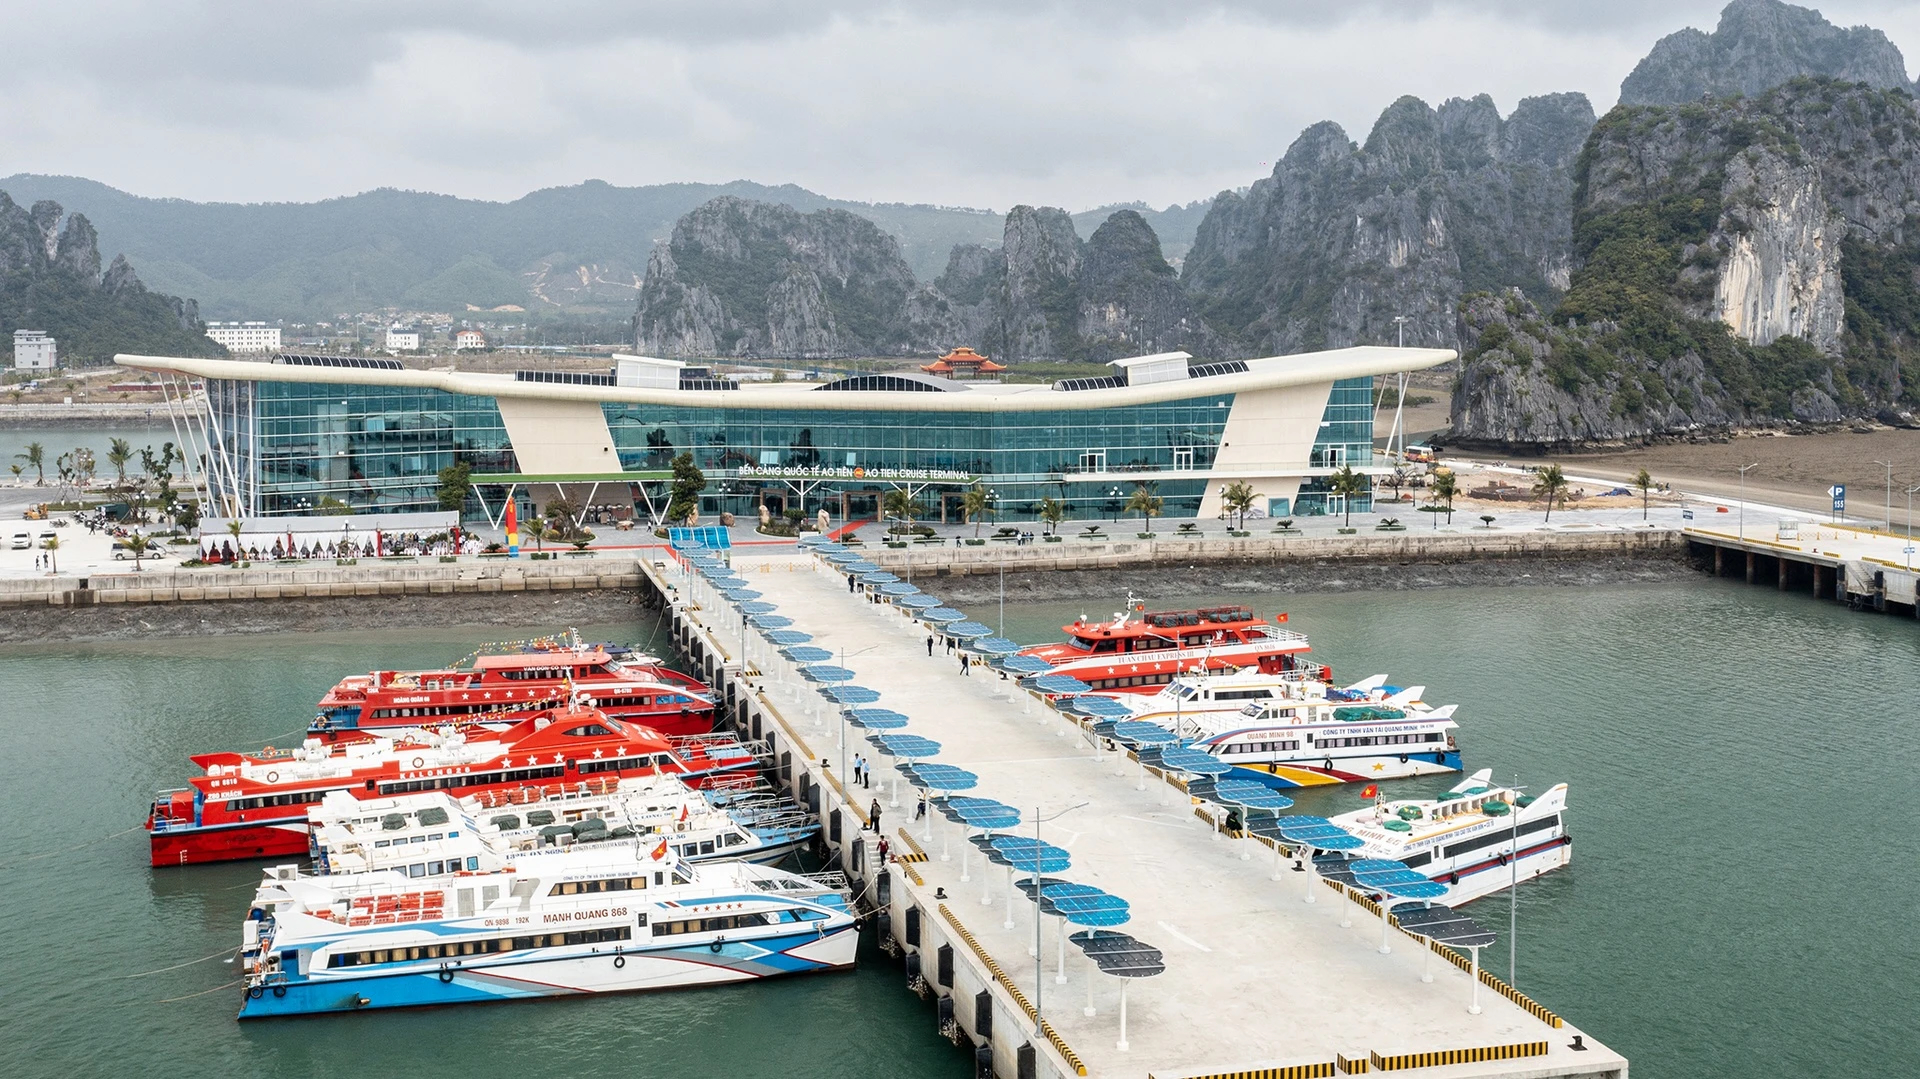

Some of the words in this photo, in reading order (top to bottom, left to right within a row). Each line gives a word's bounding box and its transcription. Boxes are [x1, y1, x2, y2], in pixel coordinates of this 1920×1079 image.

[864, 469, 879, 478] AO
[880, 469, 897, 478] TIEN
[899, 469, 927, 479] CRUISE
[929, 470, 970, 480] TERMINAL
[1835, 487, 1843, 496] P
[574, 909, 609, 920] QUANG
[611, 907, 628, 917] 868
